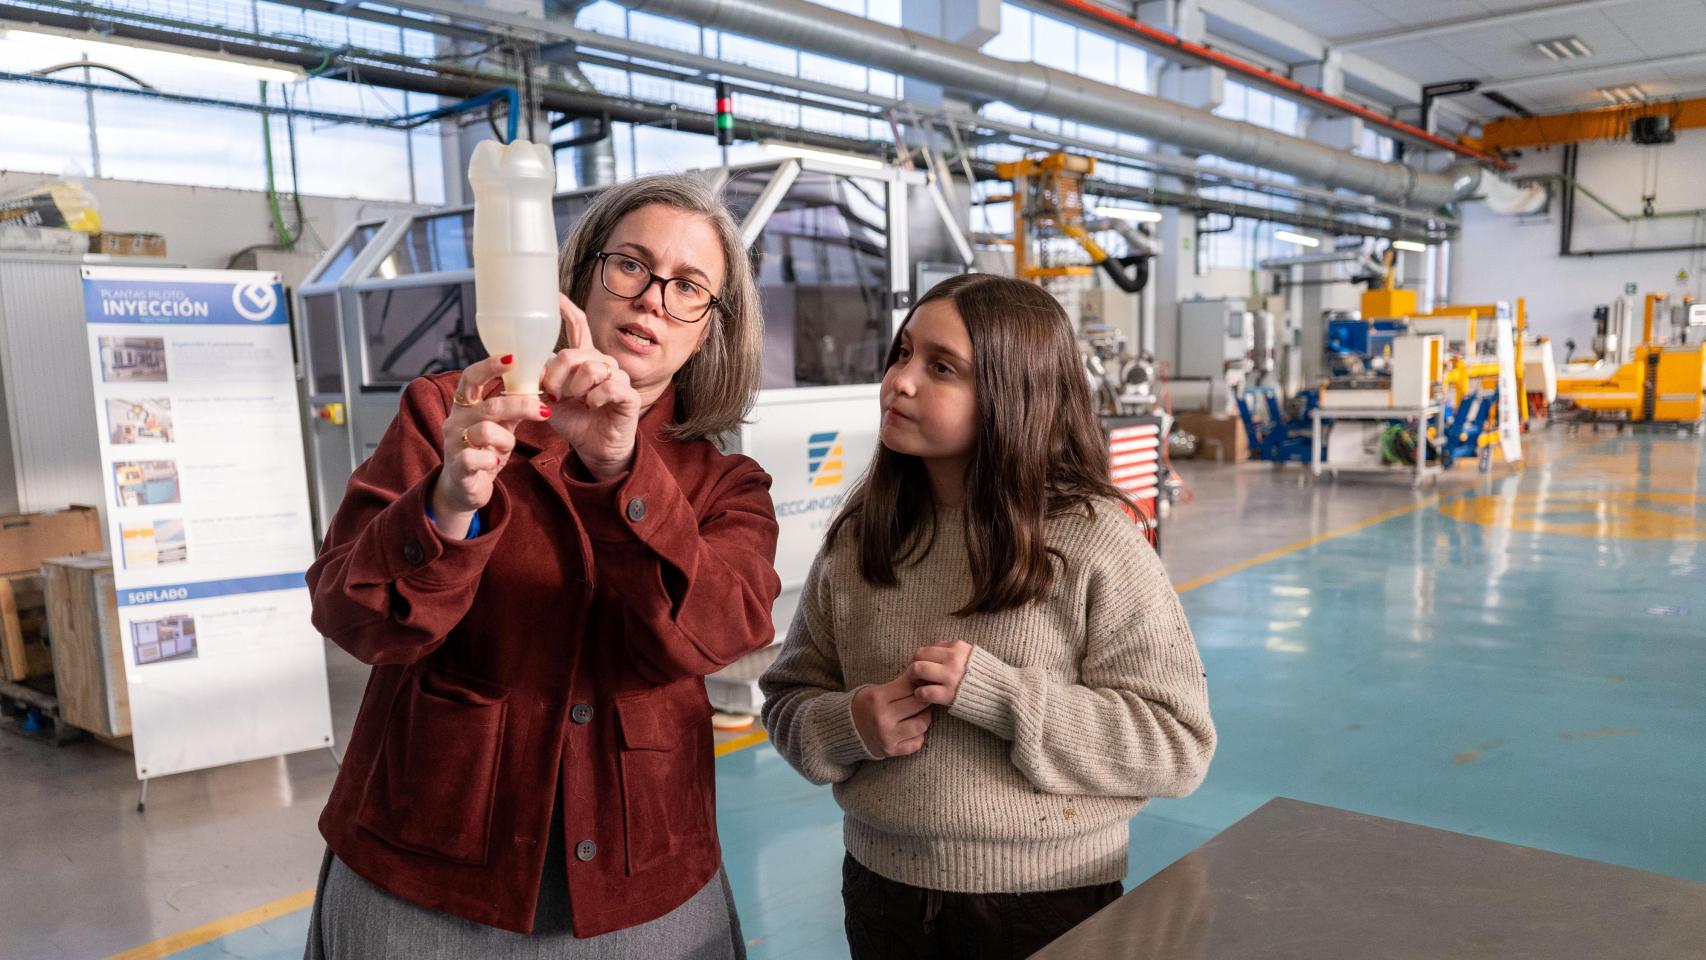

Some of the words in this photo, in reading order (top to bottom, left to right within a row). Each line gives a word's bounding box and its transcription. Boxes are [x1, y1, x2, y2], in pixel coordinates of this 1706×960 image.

[101, 289, 147, 299] PLANTAS
[148, 290, 185, 300] PILOTO
[103, 297, 209, 317] INYECCIÓN
[128, 587, 188, 605] SOPLADO
